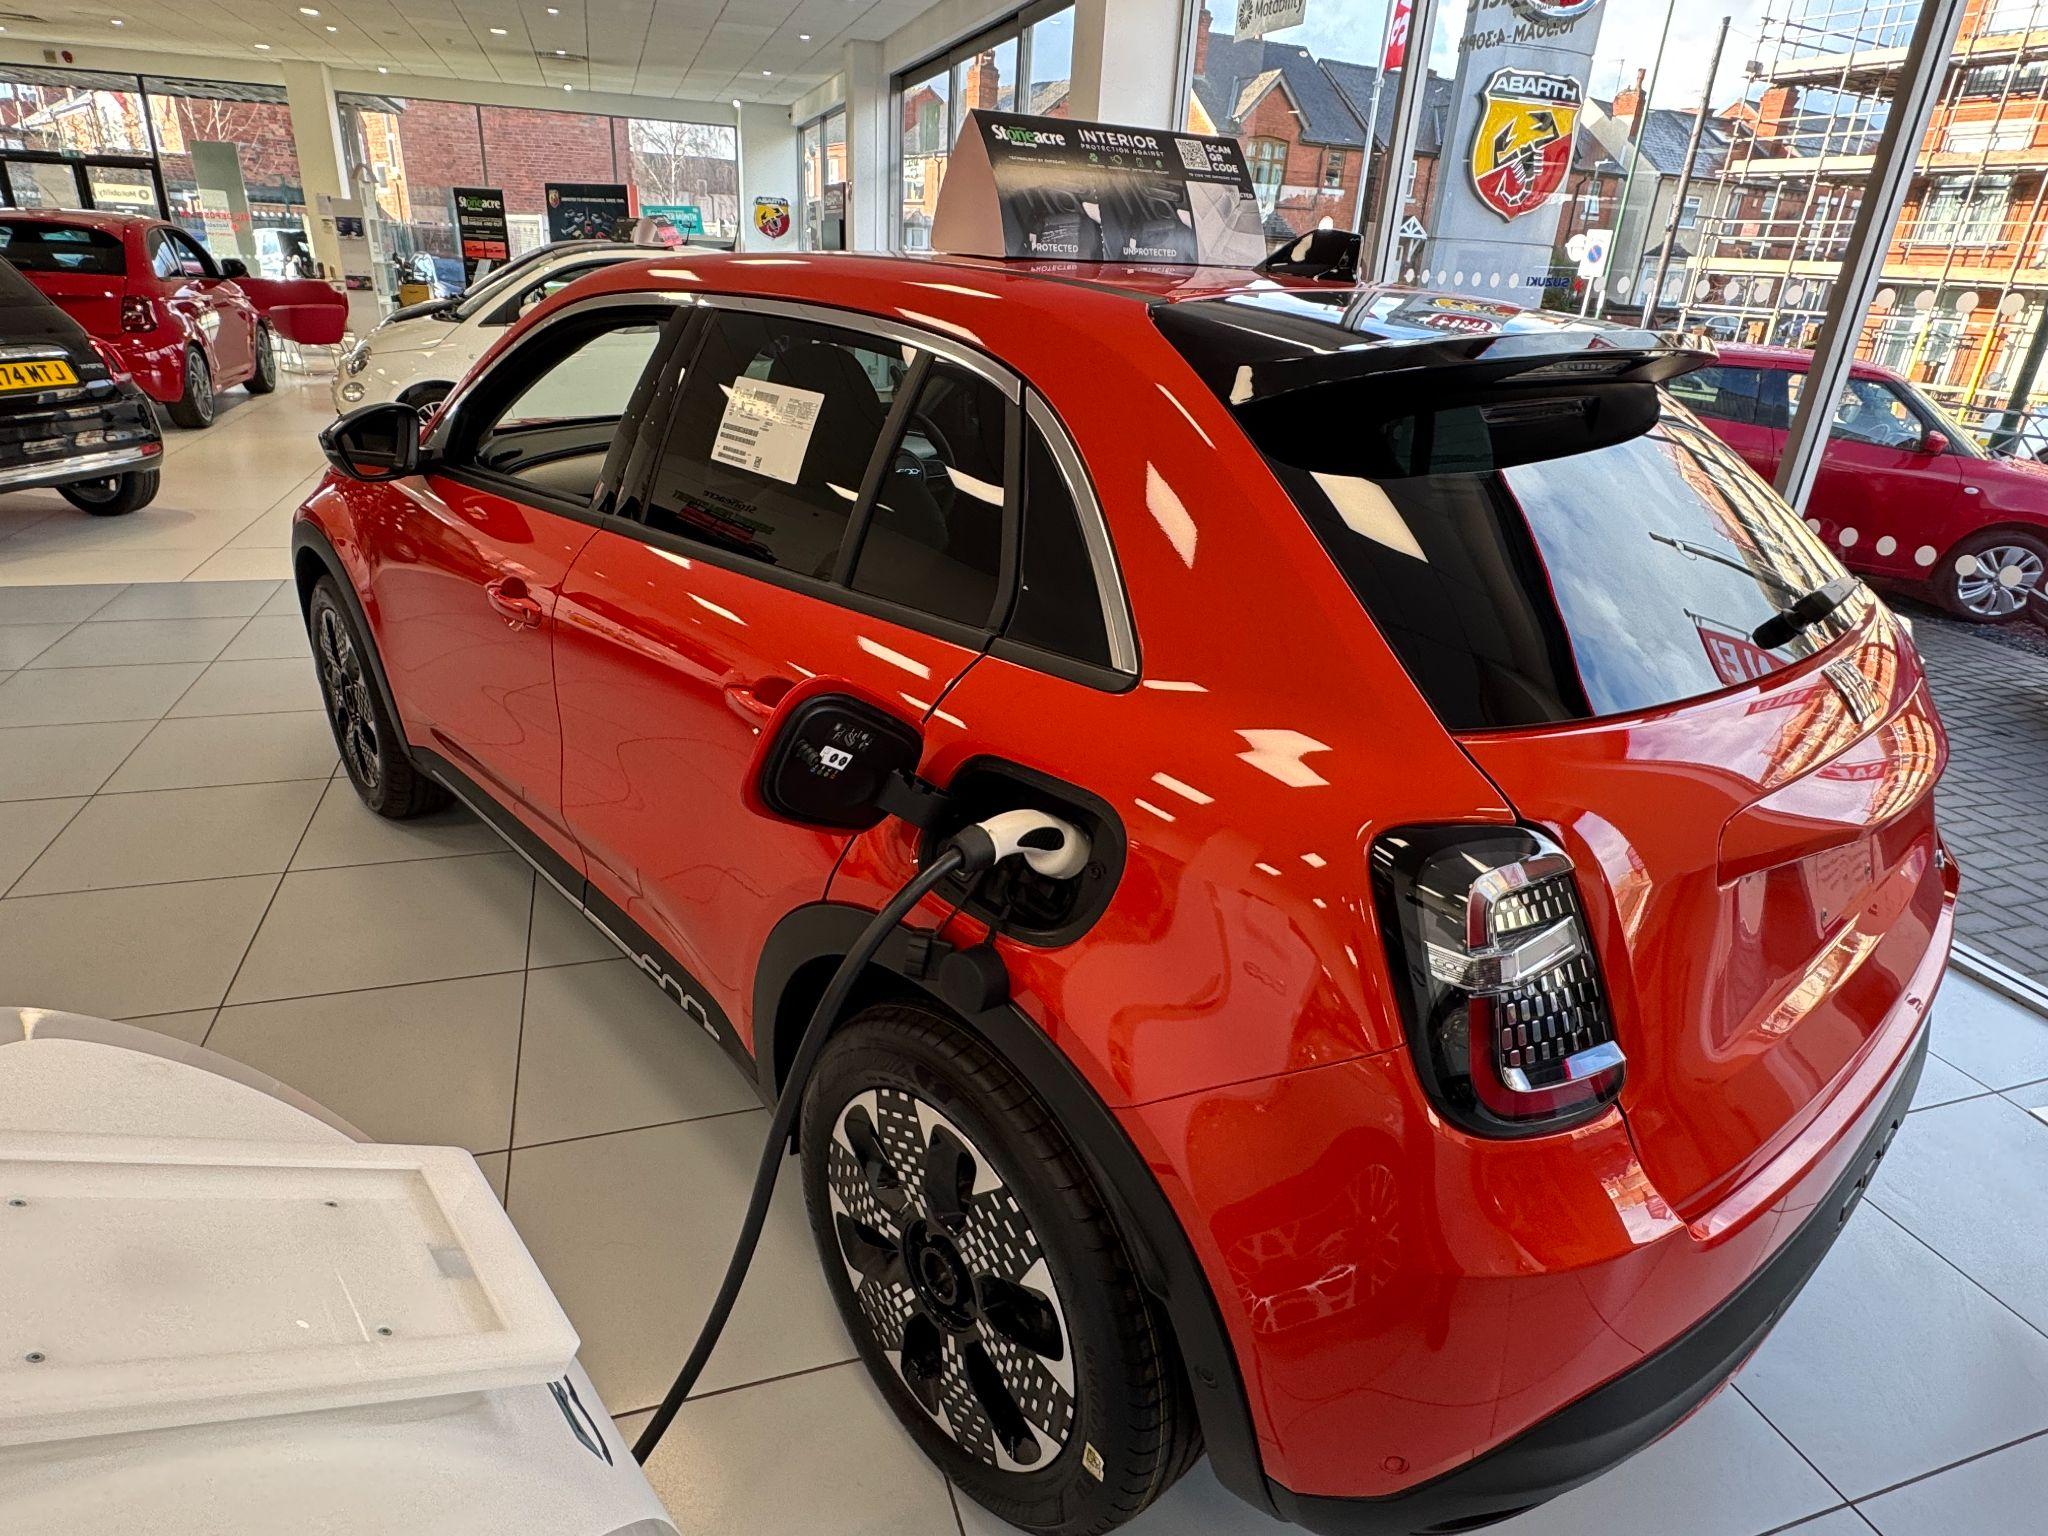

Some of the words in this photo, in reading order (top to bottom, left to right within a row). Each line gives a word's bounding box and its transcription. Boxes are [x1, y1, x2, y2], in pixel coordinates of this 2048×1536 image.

[1492, 76, 1578, 101] ABARTH
[991, 124, 1066, 147] Stoneacre
[1078, 128, 1159, 150] INTERIOR
[1080, 142, 1130, 154] PROTECTION
[1132, 148, 1165, 157] AGAINST
[1205, 144, 1232, 155] SCAN
[1209, 153, 1224, 163] QR
[1212, 162, 1239, 174] CODE
[1031, 243, 1079, 254] PROTECTED
[1123, 246, 1177, 257] UNPROTECTED
[0, 366, 27, 386] 74
[22, 364, 66, 384] MTJ
